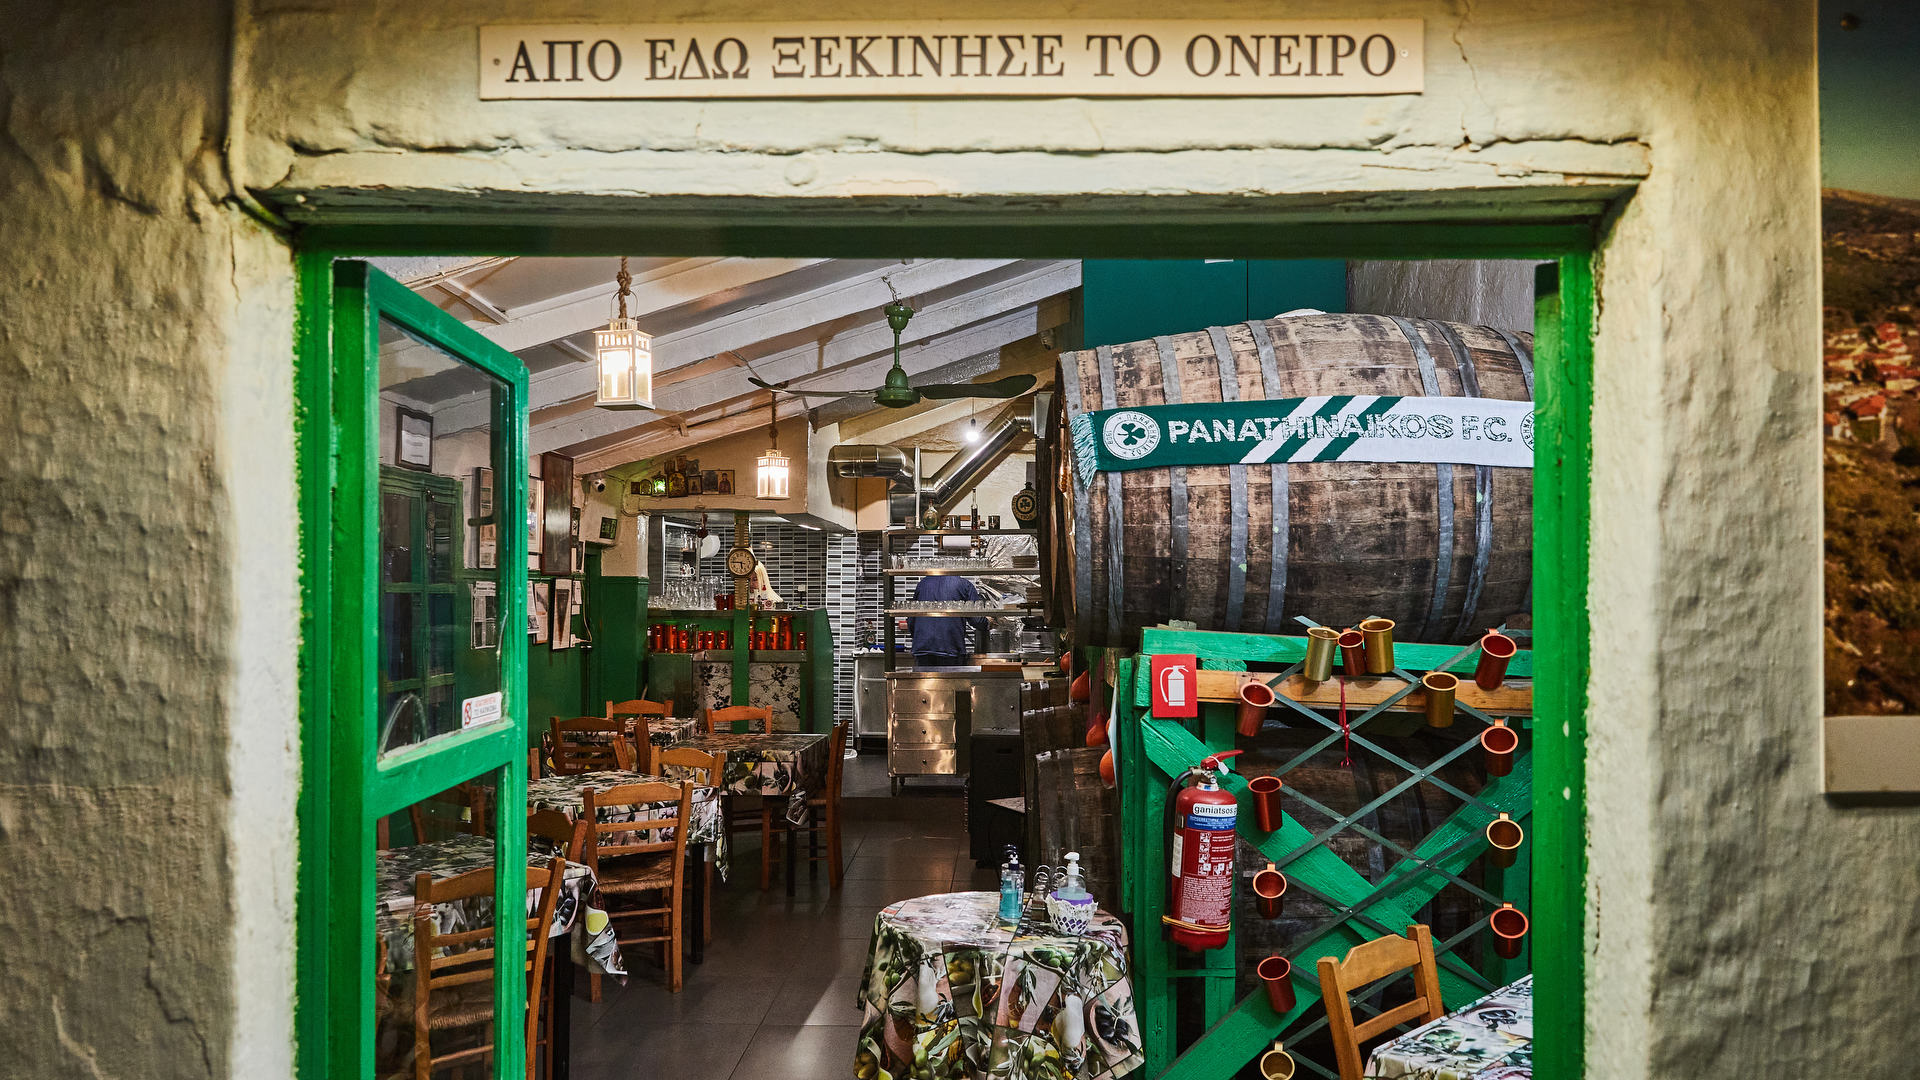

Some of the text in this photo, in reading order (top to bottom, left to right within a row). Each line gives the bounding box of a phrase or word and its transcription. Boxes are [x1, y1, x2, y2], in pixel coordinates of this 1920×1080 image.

[505, 33, 1397, 83] ΑΠΟ ΕΔΩ ΞΕΚΙΝΗΣΕ ΤΟ ΟΝΕΙΡΟ
[1167, 414, 1513, 444] PANATHINAIKOS F.C.
